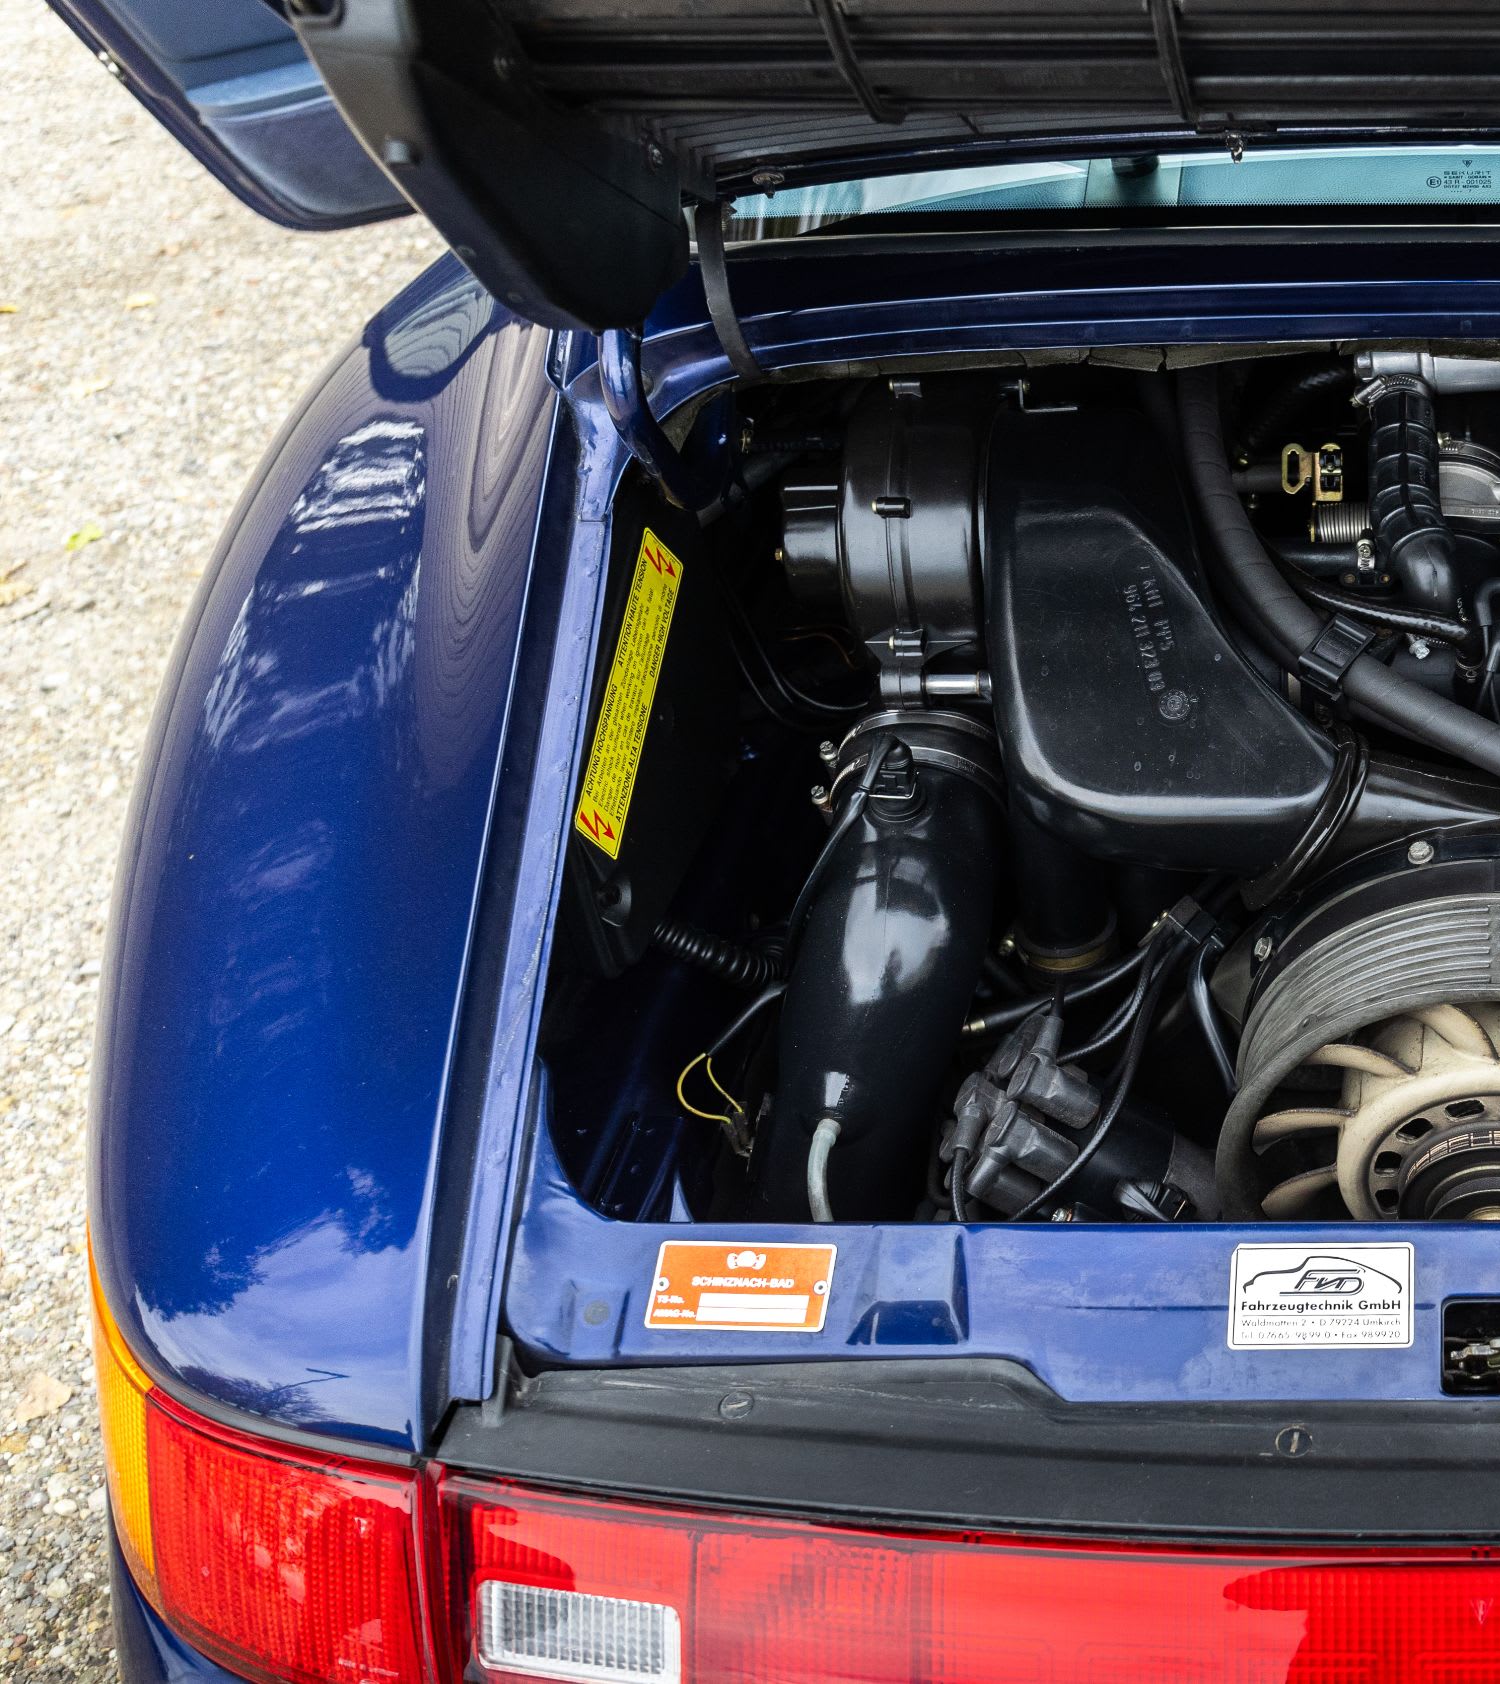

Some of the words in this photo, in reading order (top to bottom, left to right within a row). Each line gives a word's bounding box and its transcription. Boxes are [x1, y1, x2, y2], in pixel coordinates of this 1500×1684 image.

[617, 621, 633, 668] ATTENTION
[628, 593, 640, 622] HAUTE
[635, 558, 648, 593] TENSION
[649, 644, 661, 678] DANGER
[657, 623, 666, 645] HIGH
[662, 587, 674, 624] VOLTAGE
[619, 702, 628, 721] when
[625, 672, 635, 699] working
[585, 754, 601, 797] ACHTUNG
[596, 683, 618, 754] HOCHSPANNUNG
[615, 768, 632, 823] ATTENZIONE
[628, 746, 638, 769] ALTA
[633, 703, 648, 744] TENSIONE
[596, 757, 608, 787] Arbeiten
[603, 786, 613, 812] Danger
[614, 752, 622, 770] mort
[691, 1275, 795, 1289] SCHINZNACH-BAD
[1241, 1299, 1353, 1314] Fahrzeugtechnik
[1358, 1299, 1401, 1310] GmbH
[1301, 1318, 1307, 1327] 2
[1362, 1317, 1401, 1327] Umkirch
[1341, 1330, 1357, 1339] Fax
